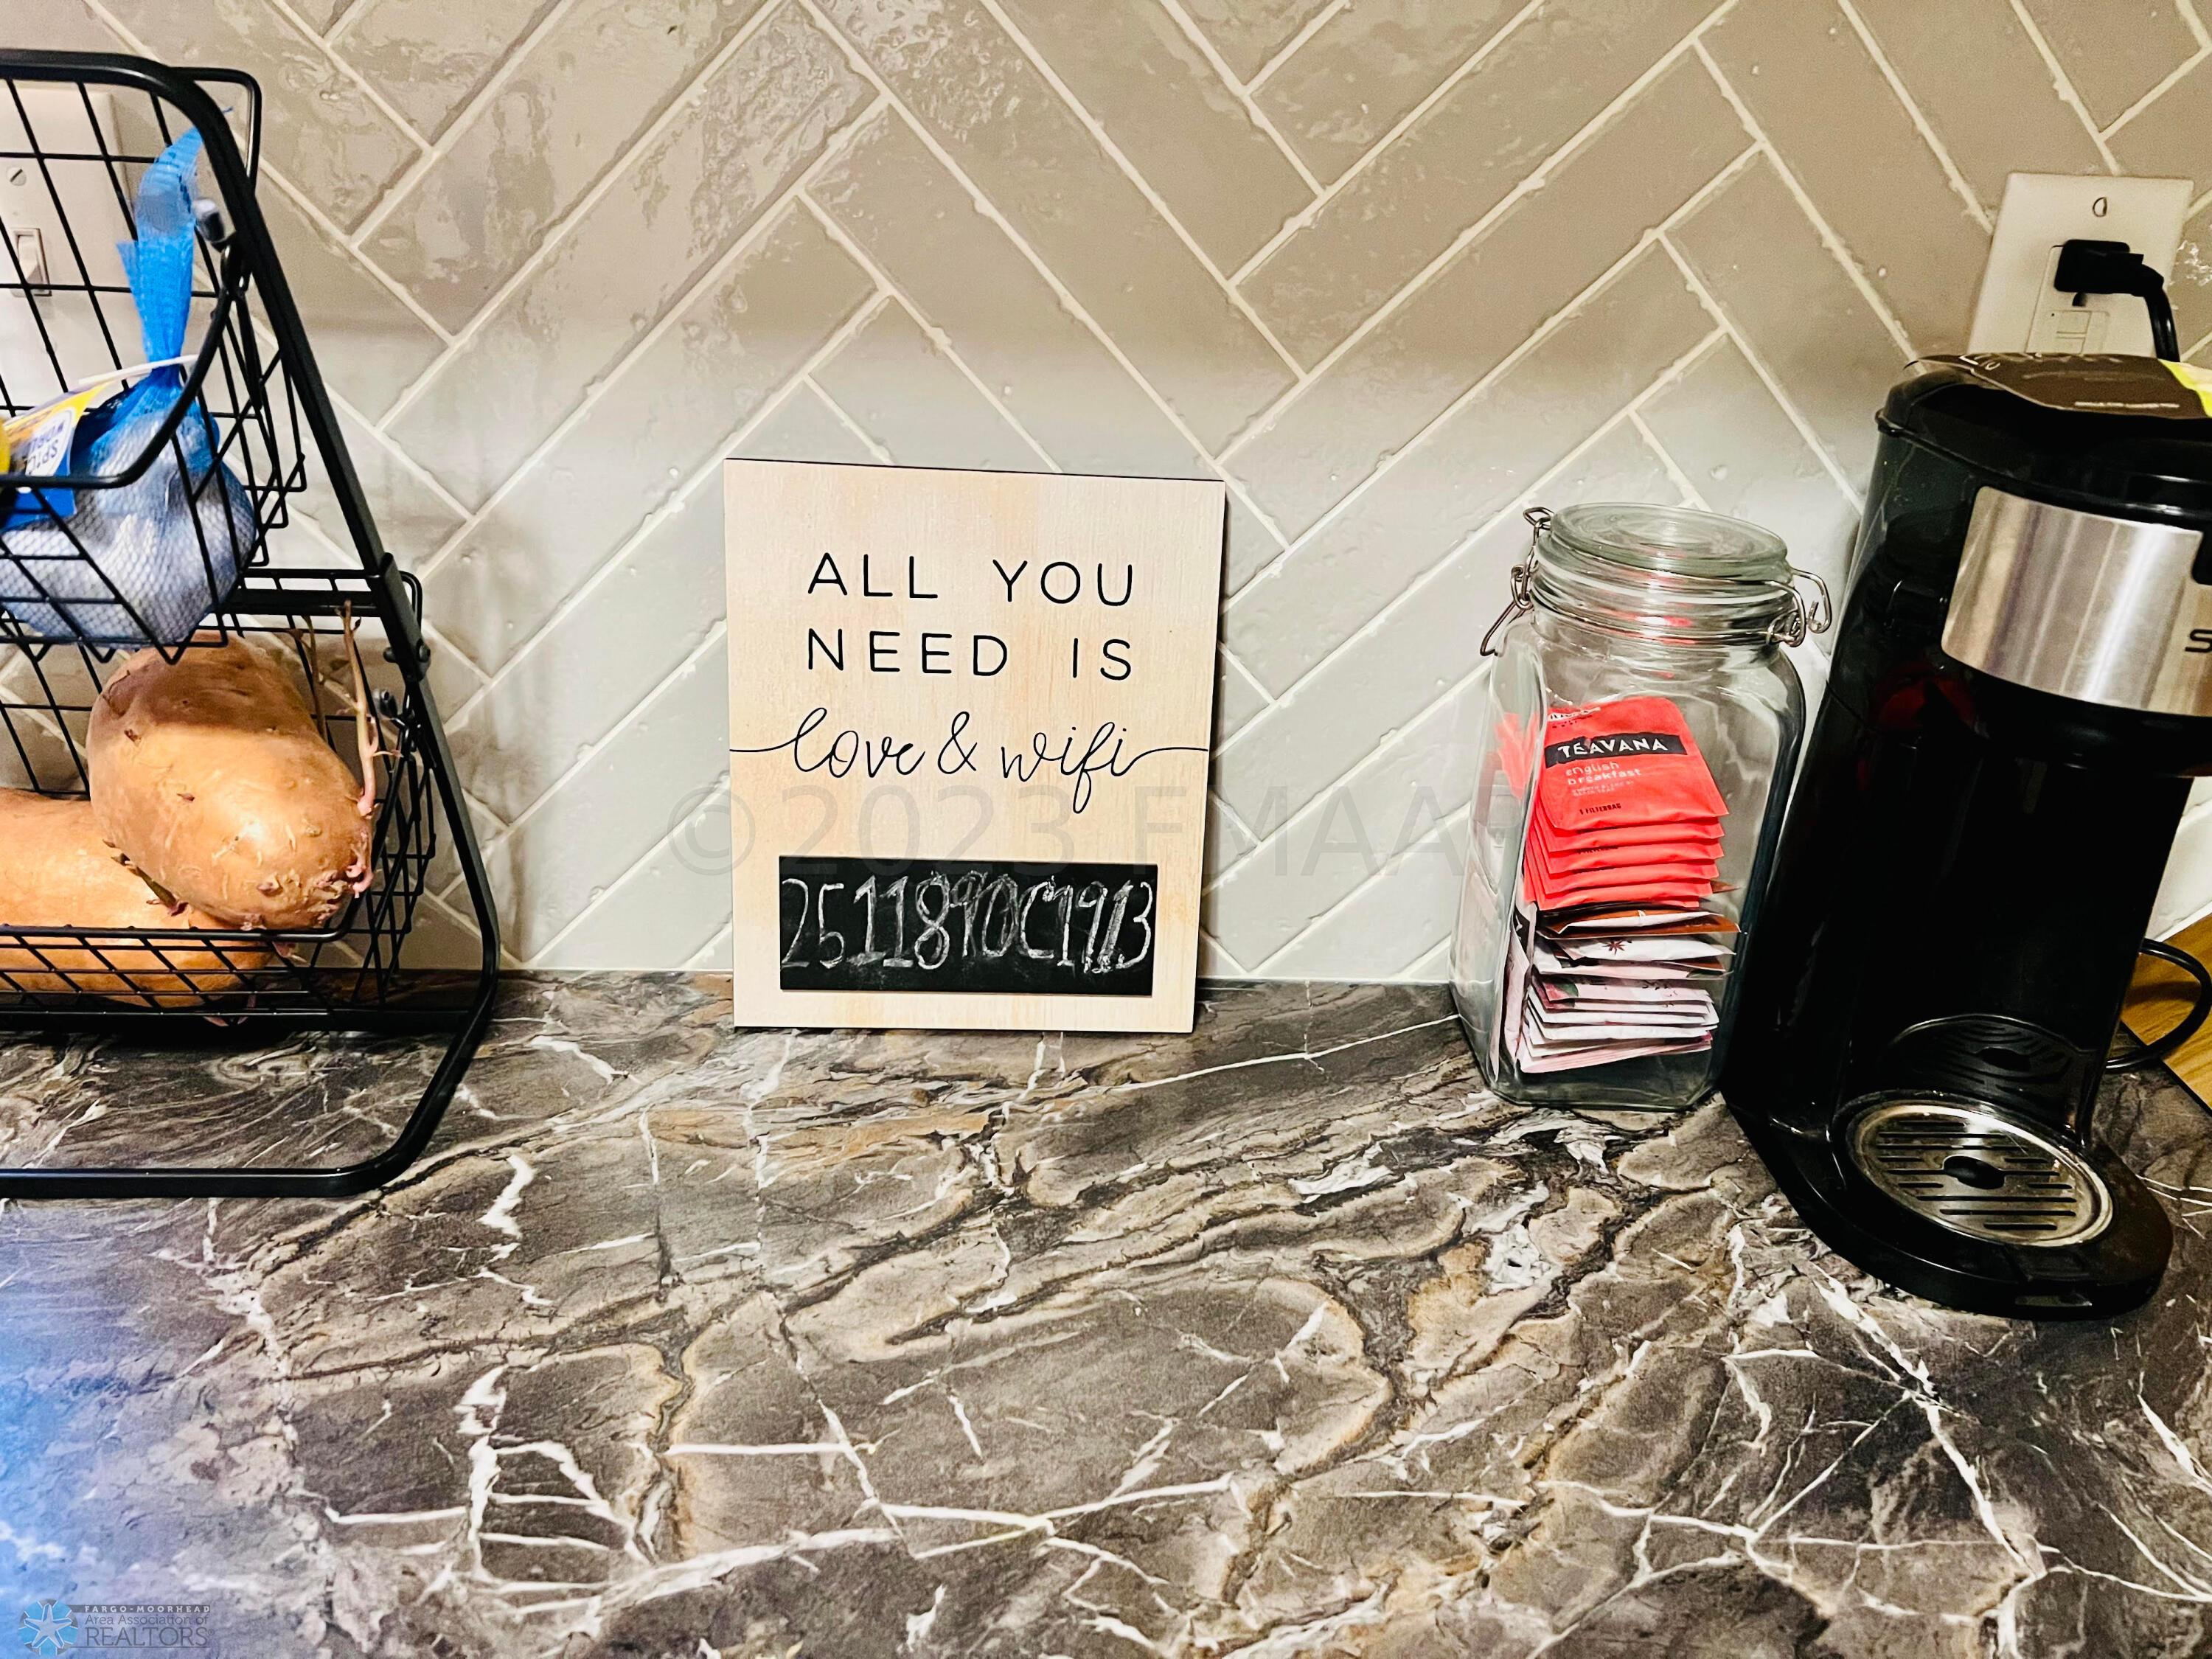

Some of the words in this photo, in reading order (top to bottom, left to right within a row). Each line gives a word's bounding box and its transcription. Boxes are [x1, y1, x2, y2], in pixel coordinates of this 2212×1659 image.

[807, 552, 939, 599] ALL
[992, 559, 1133, 607] YOU
[808, 627, 1008, 677] NEED
[1073, 638, 1132, 681] IS
[774, 707, 926, 778] love
[936, 711, 978, 775] &
[1001, 721, 1165, 814] wifi
[1557, 738, 1669, 758] TEAVANA
[1565, 762, 1620, 776] english
[1567, 768, 1642, 785] breakfast
